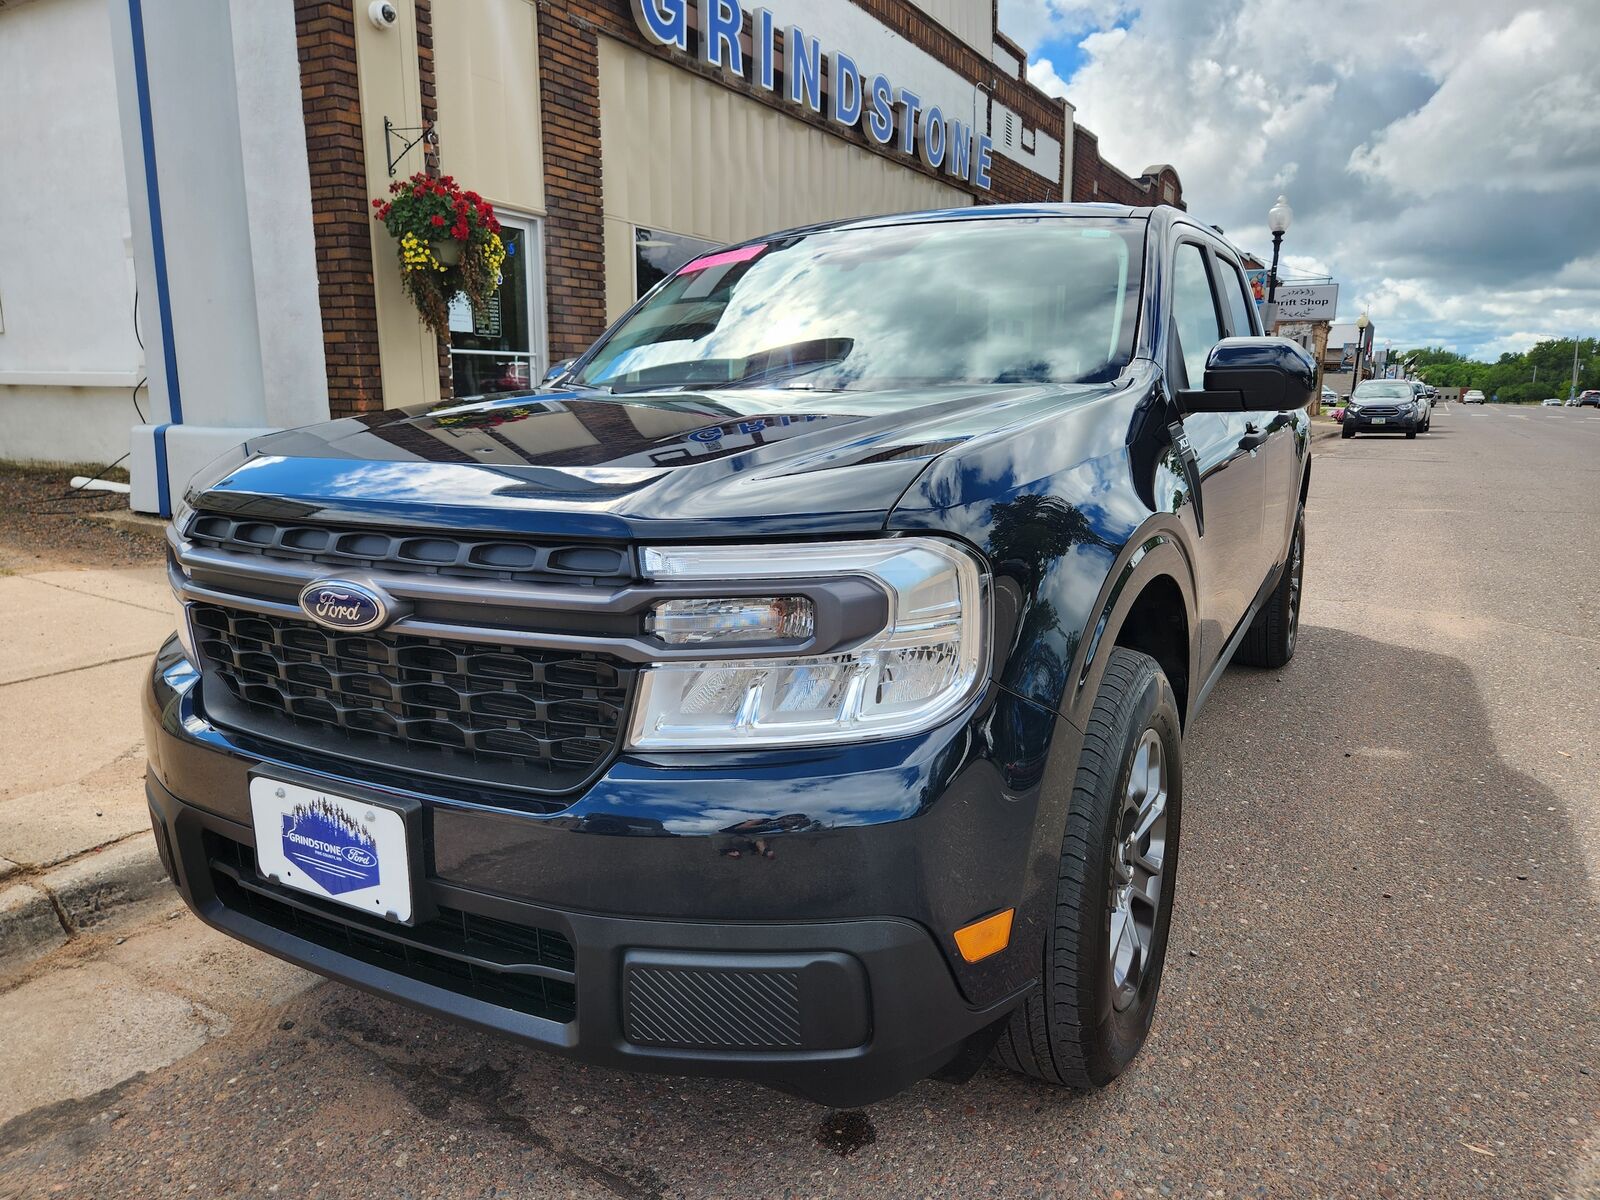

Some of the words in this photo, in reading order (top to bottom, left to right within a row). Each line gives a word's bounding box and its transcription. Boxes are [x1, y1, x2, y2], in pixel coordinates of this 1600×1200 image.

[636, 0, 993, 191] GRINDSTONE
[1300, 298, 1329, 307] Shop
[316, 591, 361, 620] Ford
[289, 832, 342, 856] GRINDSTONE
[347, 848, 370, 865] Ford
